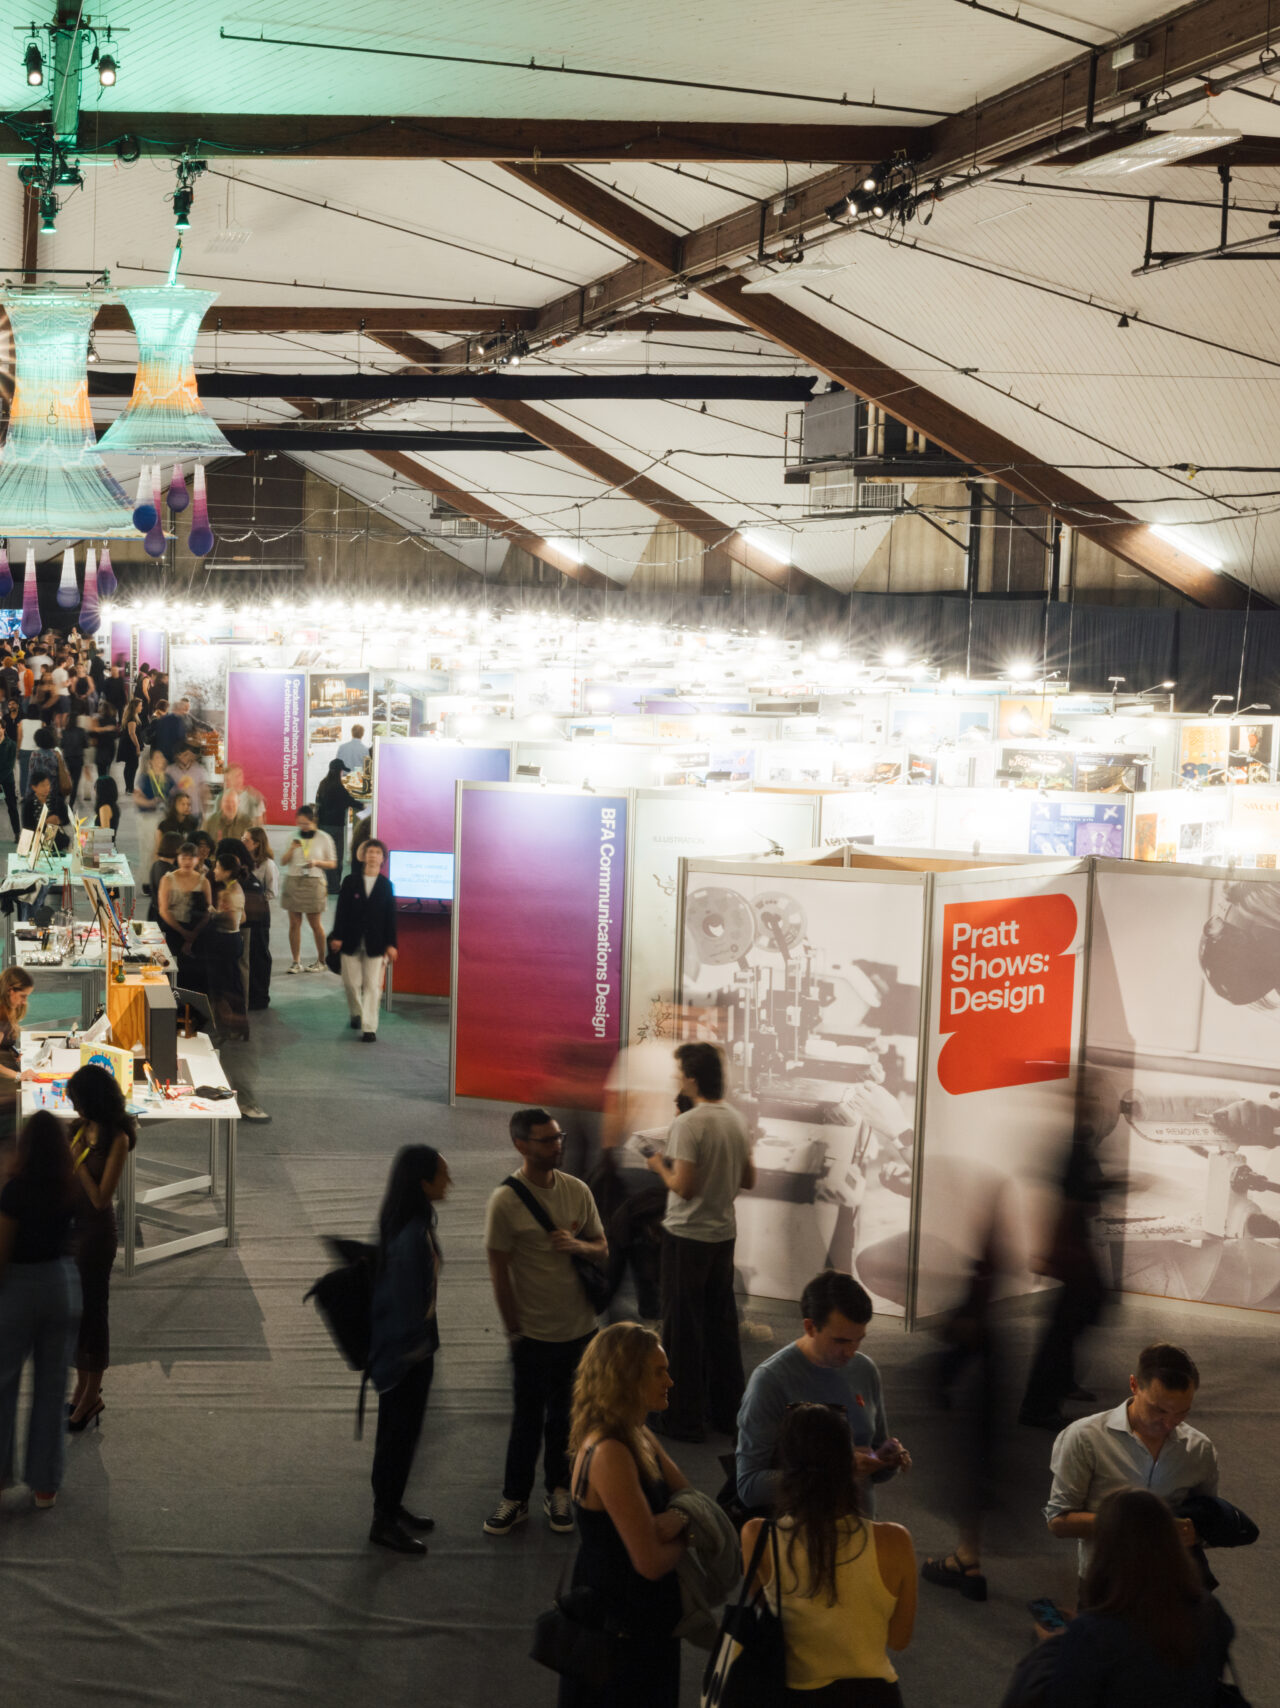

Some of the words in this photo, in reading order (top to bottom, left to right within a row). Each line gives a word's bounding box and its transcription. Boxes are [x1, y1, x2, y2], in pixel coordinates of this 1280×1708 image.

[282, 679, 292, 735] Architecture,
[292, 679, 301, 716] Graduate
[282, 736, 291, 753] and
[291, 716, 300, 768] Architecture,
[282, 754, 291, 781] Urban
[280, 781, 290, 812] Design
[290, 768, 299, 810] Landscape
[600, 807, 616, 841] BFA
[595, 843, 615, 981] Communications
[952, 920, 1020, 951] Pratt
[950, 952, 1050, 983] Shows:
[591, 983, 611, 1038] Design
[950, 980, 1045, 1015] Design
